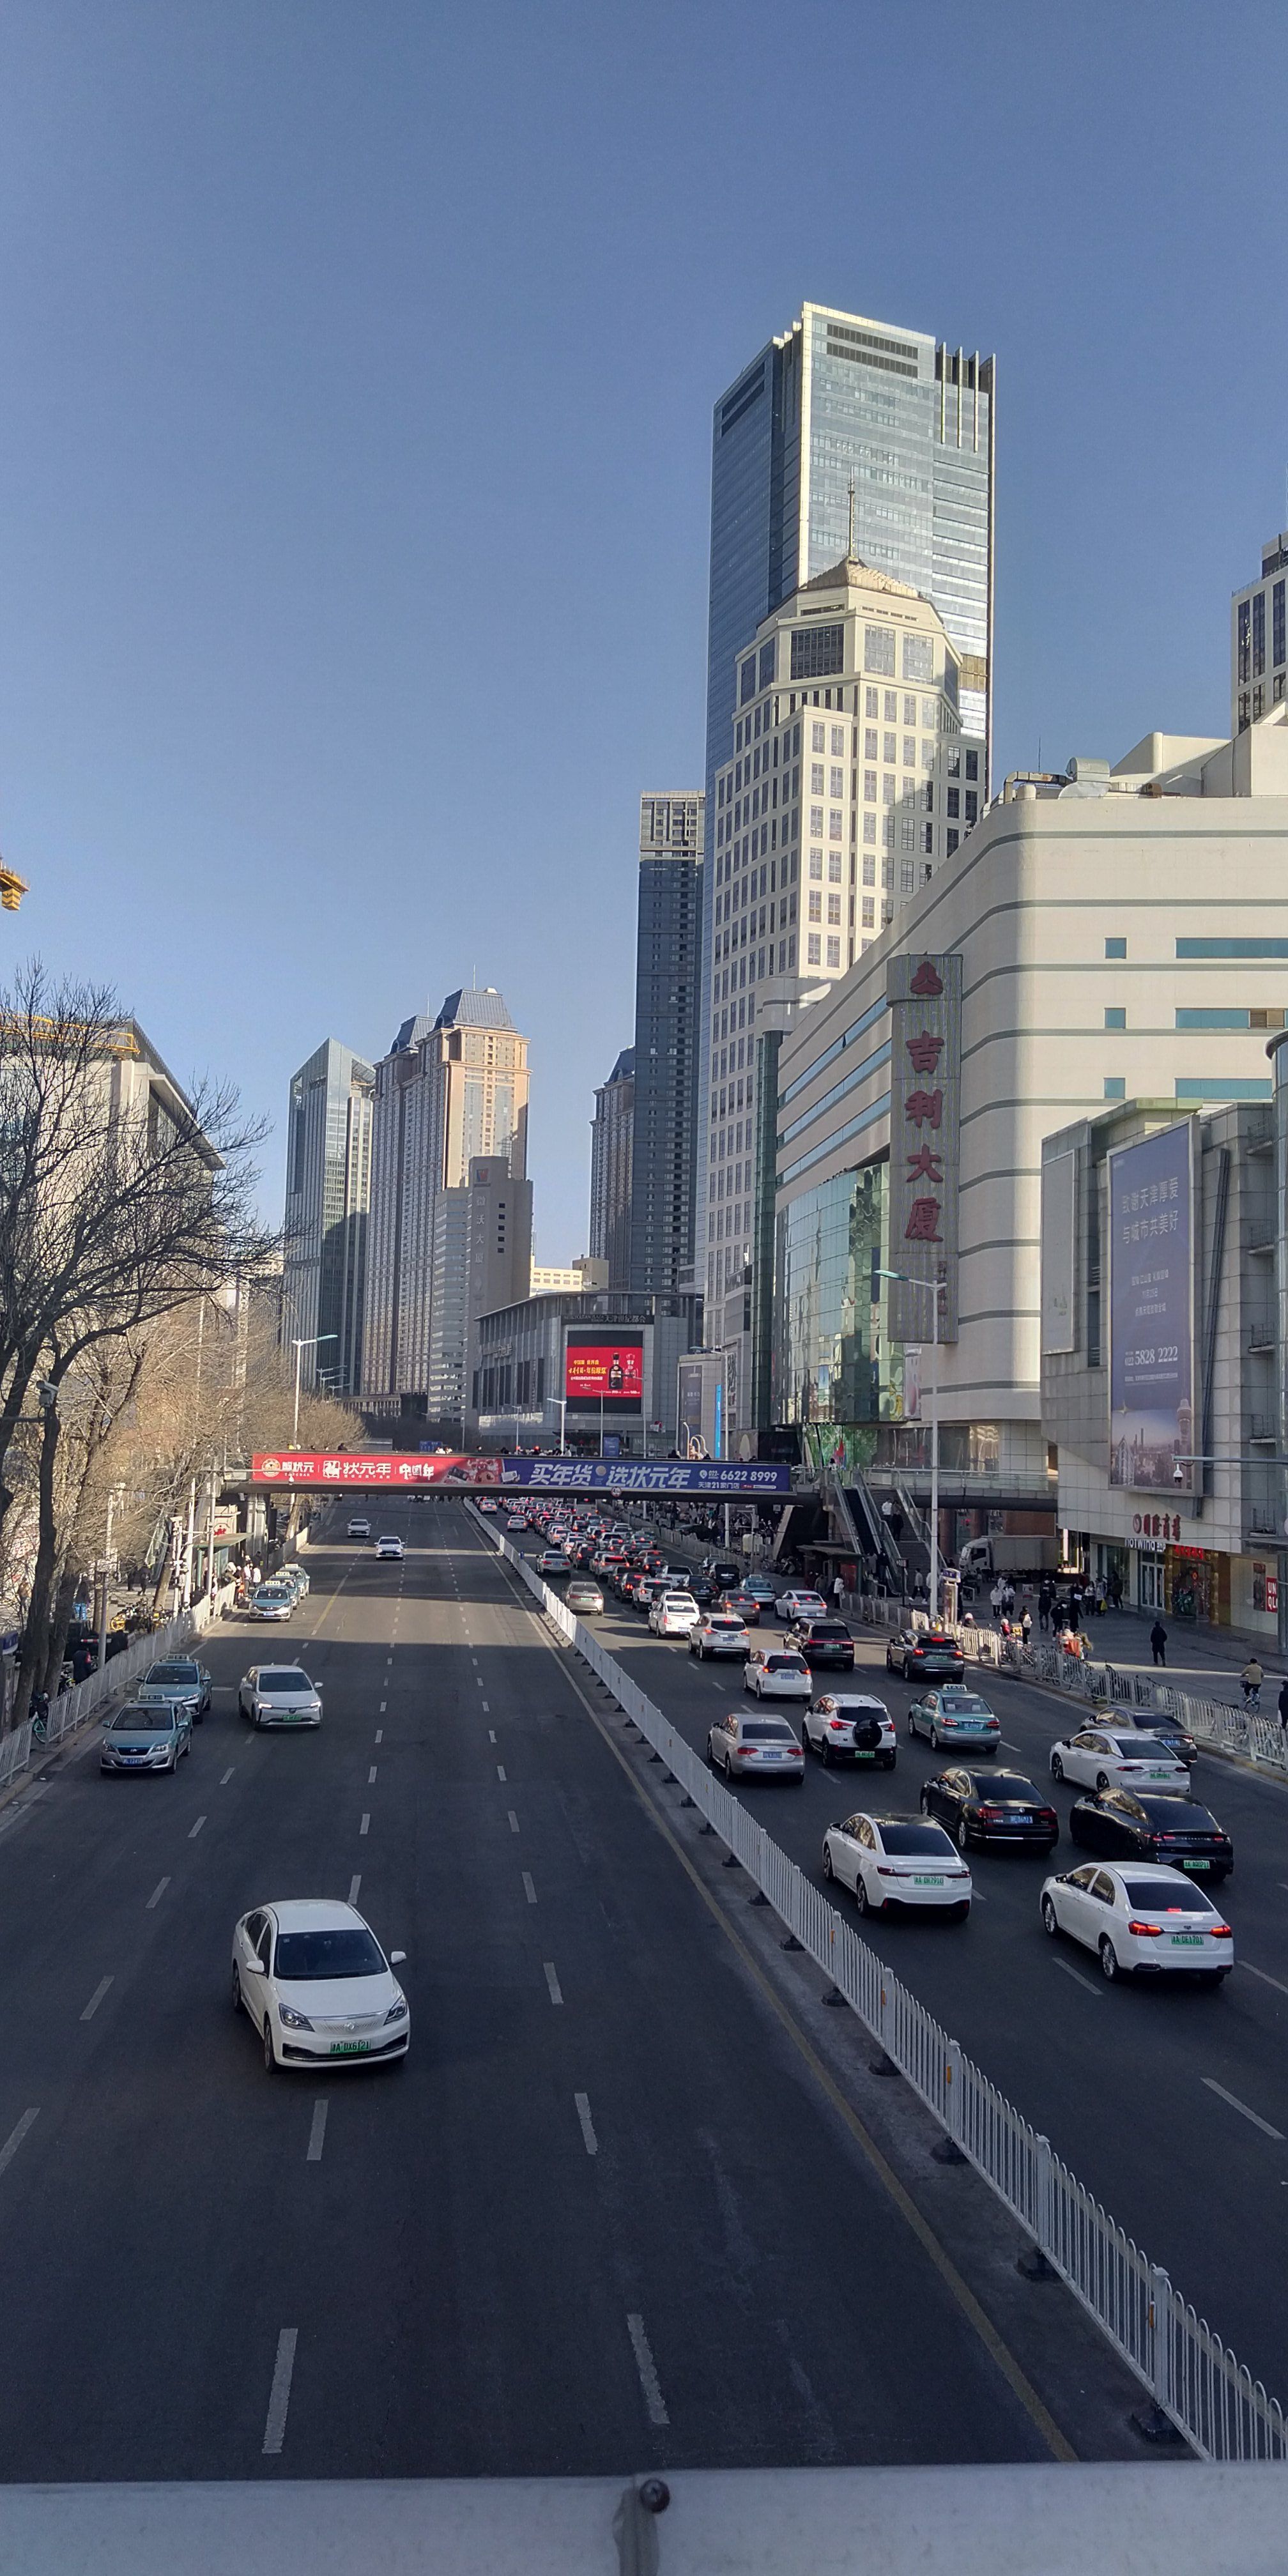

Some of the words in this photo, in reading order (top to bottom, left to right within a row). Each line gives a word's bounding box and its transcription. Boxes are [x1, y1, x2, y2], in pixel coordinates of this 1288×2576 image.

[905, 1030, 944, 1242] 吉利大厦
[1123, 1209, 1178, 1244] 与城市共美好
[1135, 1349, 1155, 1365] 5828
[1158, 1346, 1178, 1362] 2222
[343, 1462, 391, 1475] 状元年
[399, 1463, 434, 1480] 中国年
[528, 1464, 593, 1486] 买年货
[606, 1466, 691, 1488] 选状元年
[721, 1471, 747, 1480] 6622
[750, 1471, 778, 1481] 8999
